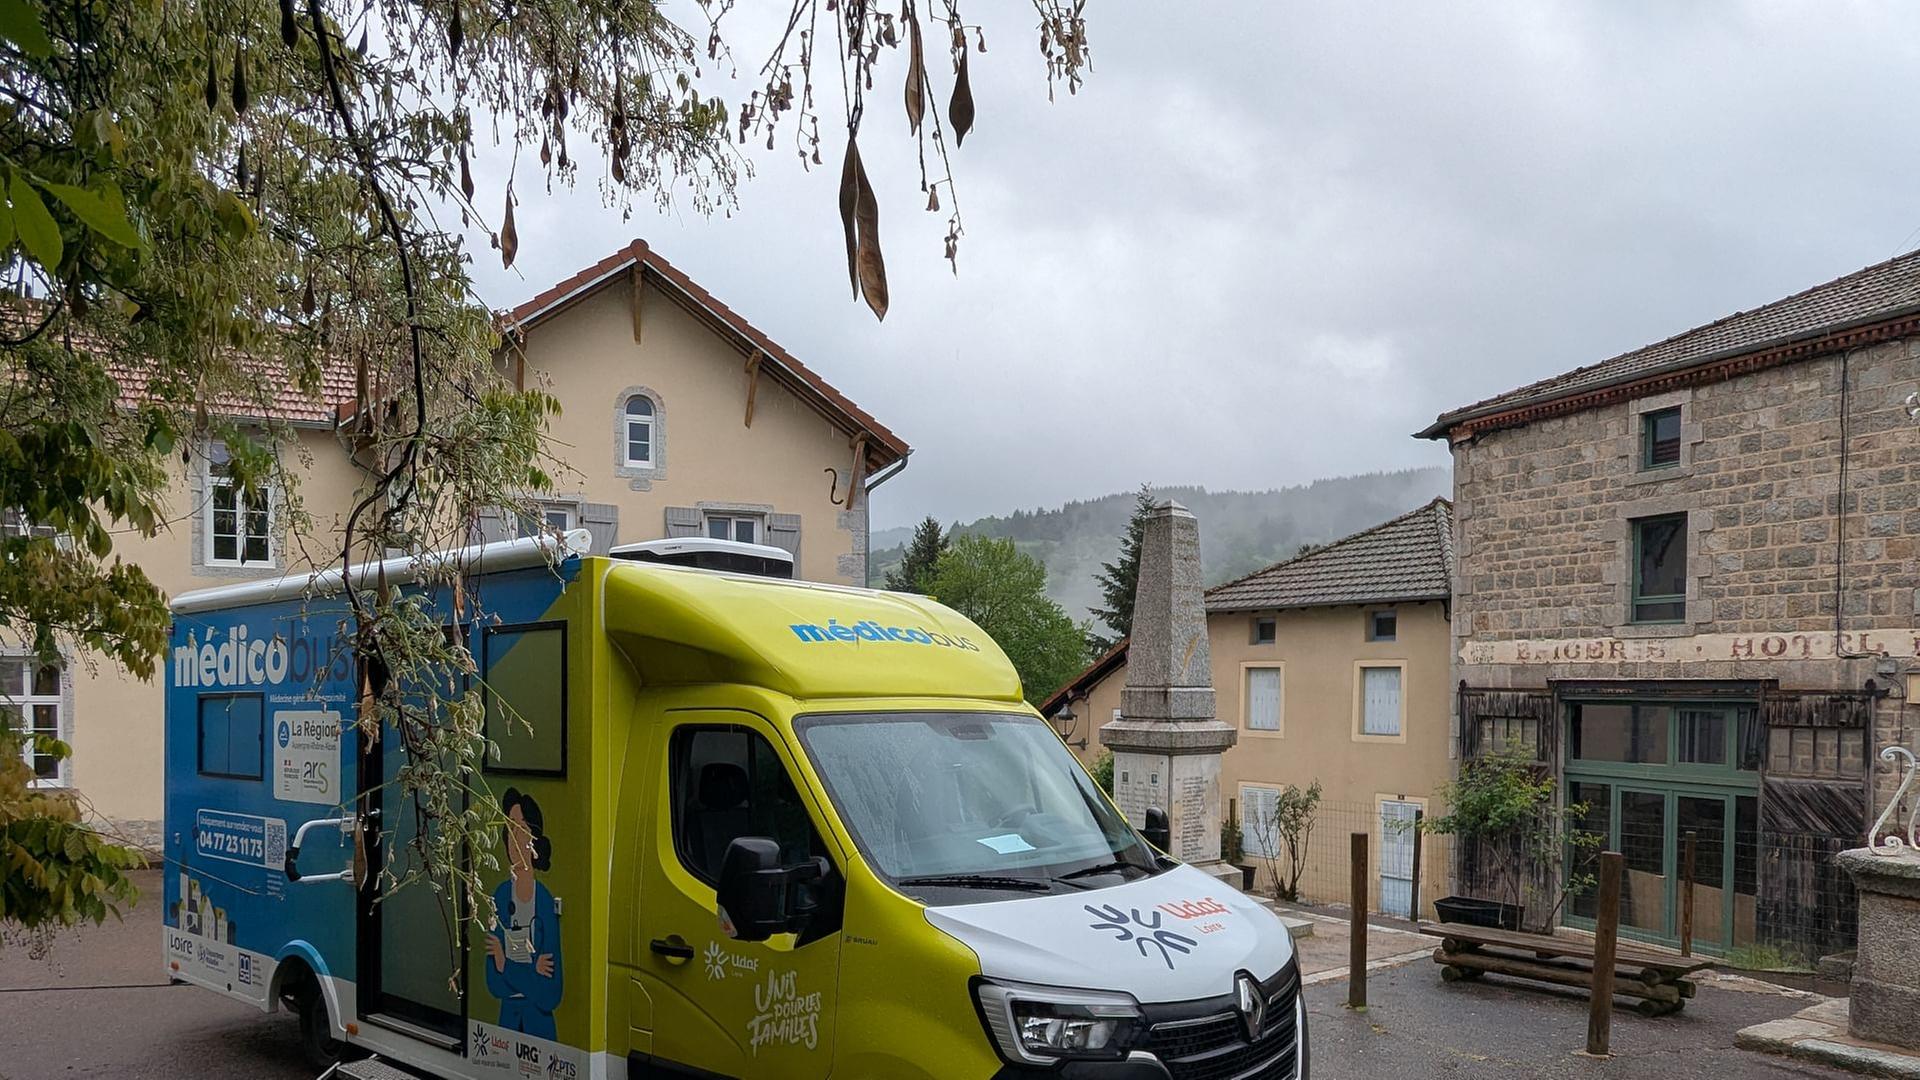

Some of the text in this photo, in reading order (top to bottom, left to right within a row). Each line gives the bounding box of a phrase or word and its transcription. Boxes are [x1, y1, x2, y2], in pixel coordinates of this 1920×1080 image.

[790, 619, 980, 652] médicobus
[174, 620, 349, 687] médicobus
[291, 719, 337, 740] La Région
[303, 761, 328, 794] ars
[200, 831, 263, 858] 04 77 23 11 73
[1158, 897, 1233, 920] Udaf
[1194, 922, 1225, 935] Loire
[170, 933, 193, 954] Loire
[731, 954, 759, 973] Udaf
